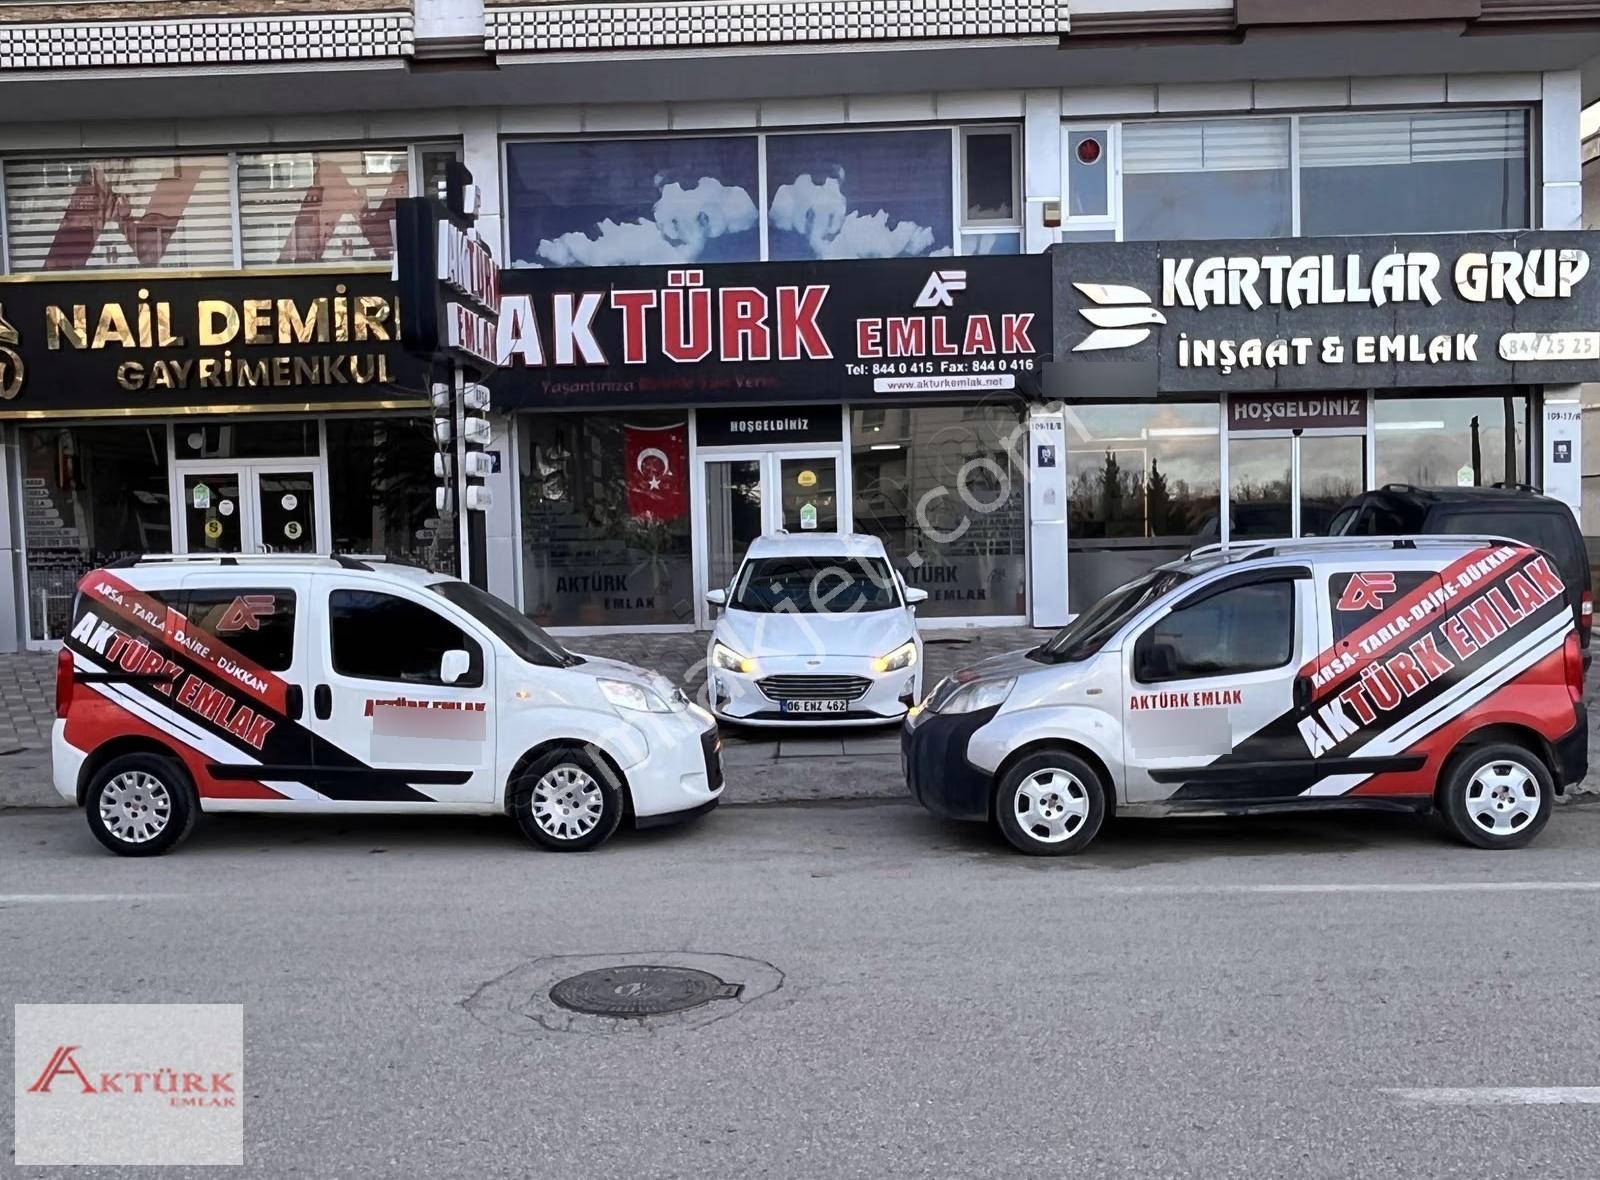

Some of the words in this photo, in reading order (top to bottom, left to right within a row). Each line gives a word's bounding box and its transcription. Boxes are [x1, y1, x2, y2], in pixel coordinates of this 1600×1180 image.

[1162, 251, 1442, 311] KARTALLAR
[1454, 247, 1591, 305] GRUP
[45, 287, 187, 350] NAİL
[198, 283, 400, 347] DEMİR
[496, 269, 834, 367] AKTÜRK
[857, 313, 1037, 359] EMLAK
[1178, 332, 1313, 374] İNŞAAT
[1321, 336, 1345, 364] &
[1356, 334, 1479, 364] EMLAK
[1572, 337, 1592, 354] 25
[115, 350, 397, 391] GAYRİMENKUL
[845, 363, 869, 376] Tel:
[872, 363, 896, 375] 844
[899, 363, 907, 374] 0
[910, 361, 934, 374] 415
[940, 360, 969, 373] Fax:
[972, 360, 996, 372] 844
[999, 359, 1007, 371] 0
[1010, 359, 1034, 371] 416
[887, 376, 1003, 391] www.akturkemlak.net
[730, 417, 809, 433] HOŞGELDİNİZ
[1233, 396, 1361, 422] HOŞGELDİNİZ
[556, 571, 628, 593] AKTÜRK
[94, 581, 125, 606] ARSA
[132, 602, 166, 632] TARLA
[173, 629, 210, 659] DAİRE
[217, 656, 269, 696] DÜKKAN
[1297, 631, 1455, 759] AKTÜRK
[1439, 554, 1566, 661] EMLAK
[70, 611, 185, 697] AKTÜRK
[175, 673, 276, 751] EMLAK
[1130, 692, 1190, 710] AKTÜRK
[1193, 689, 1243, 707] EMLAK
[786, 701, 800, 711] 06
[826, 700, 846, 711] 462
